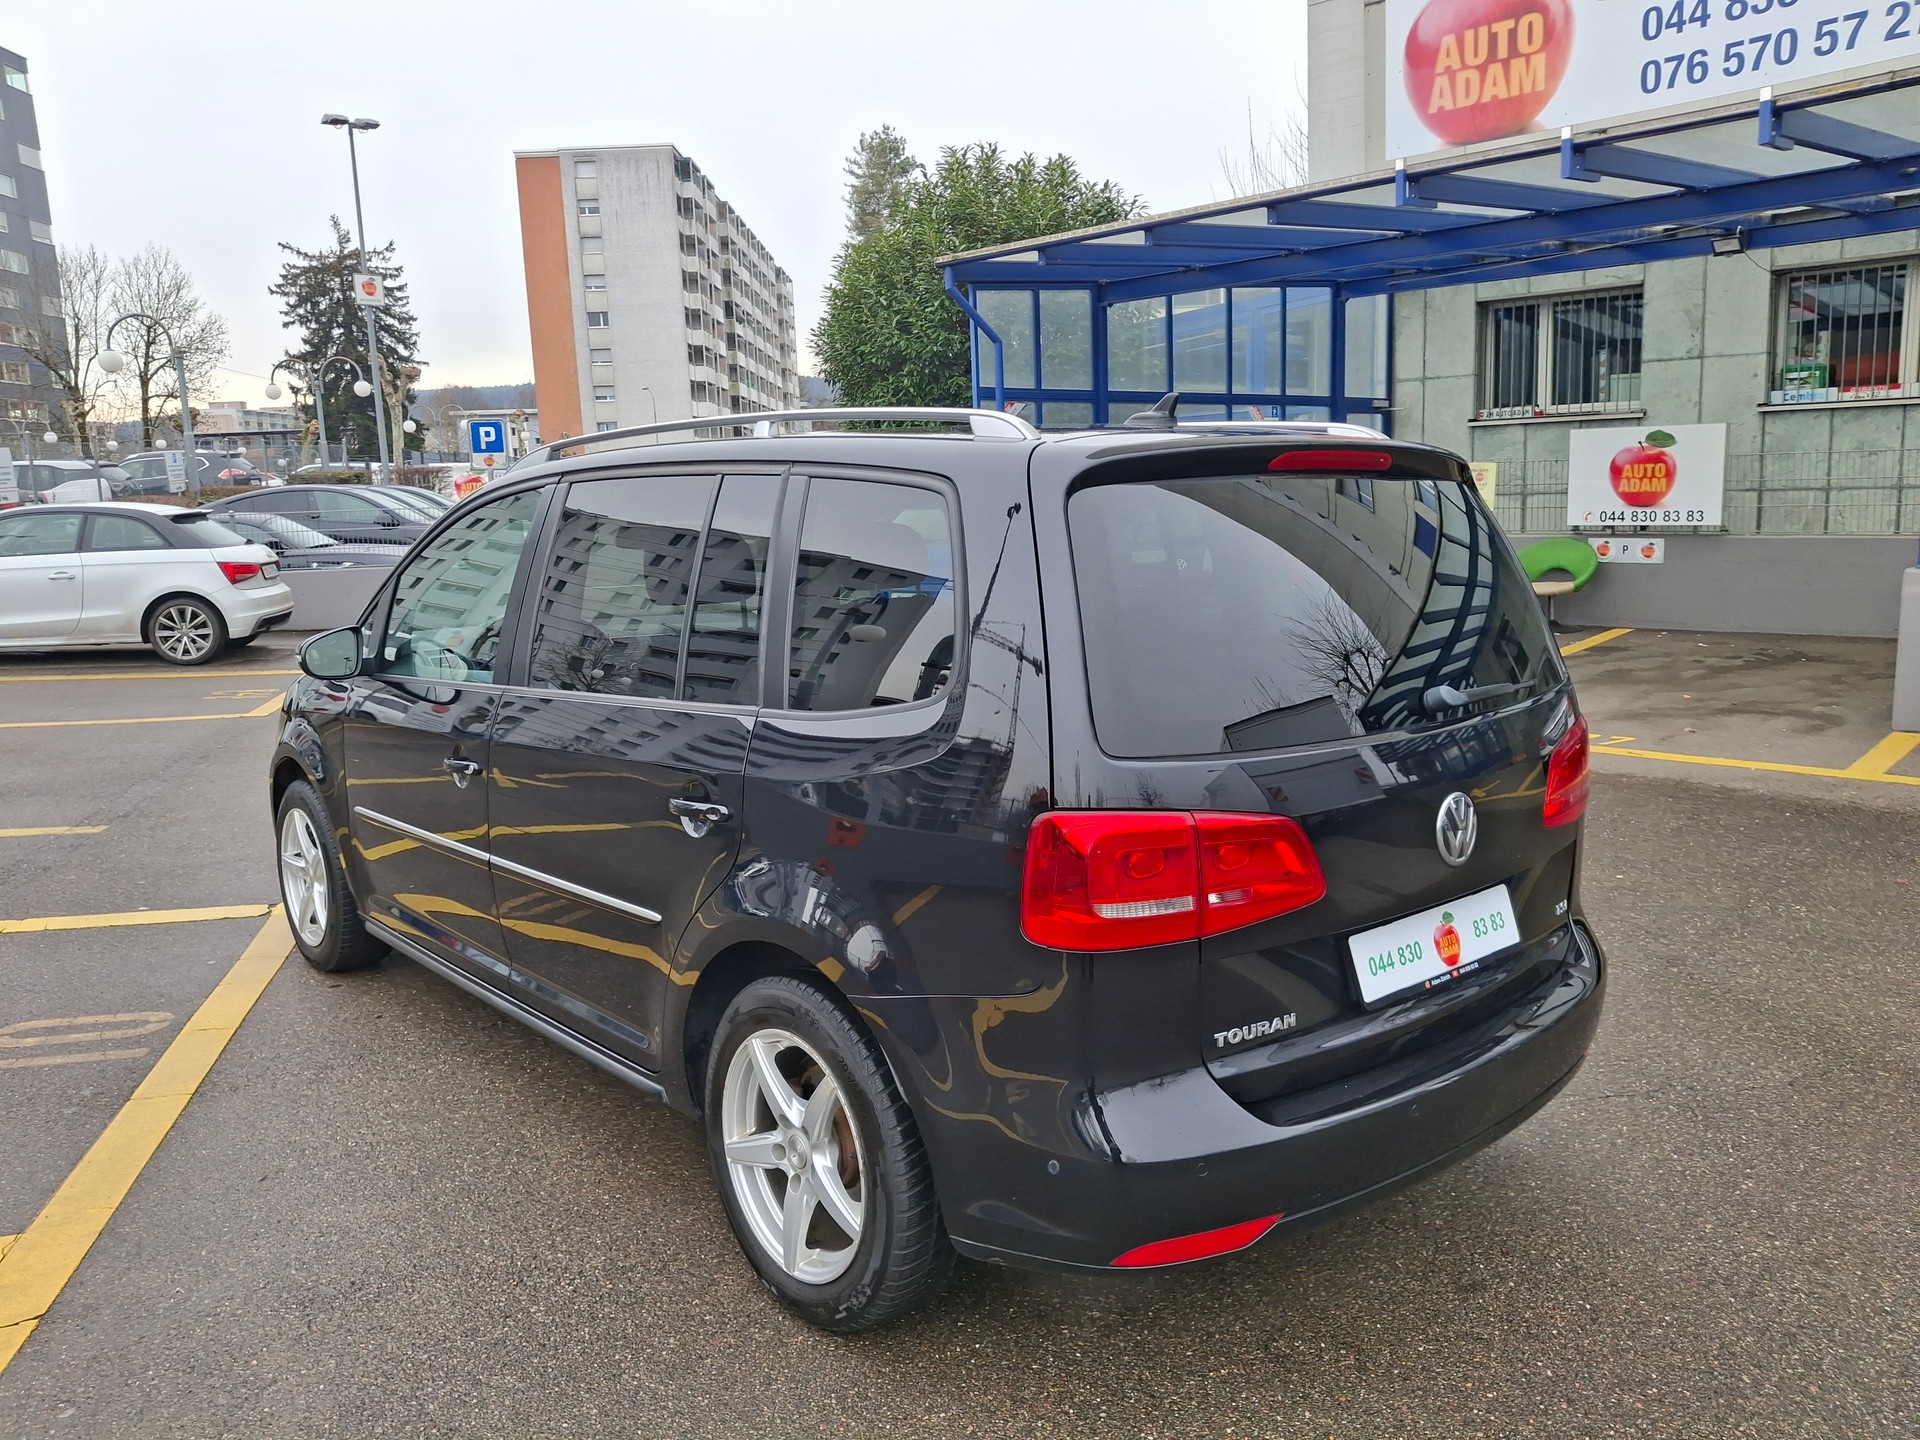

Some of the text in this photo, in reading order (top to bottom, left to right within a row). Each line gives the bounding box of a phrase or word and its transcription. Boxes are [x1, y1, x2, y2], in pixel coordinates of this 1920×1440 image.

[1641, 0, 1711, 41] 044
[1434, 12, 1545, 74] AUTO
[1640, 48, 1709, 95] 076
[1722, 27, 1799, 77] 570
[1813, 10, 1869, 57] 57
[1883, 0, 1920, 42] 2
[1428, 52, 1547, 114] ADAM
[479, 426, 496, 450] P
[1622, 462, 1667, 479] AUTO
[1618, 477, 1667, 493] ADAM
[1599, 510, 1704, 523] 044 830 83 83
[1622, 544, 1629, 555] P
[1368, 911, 1505, 977] 044 830 83 83
[1439, 933, 1457, 948] AUTO
[1440, 944, 1459, 958] ADAM
[1213, 1012, 1297, 1048] TOURAN
